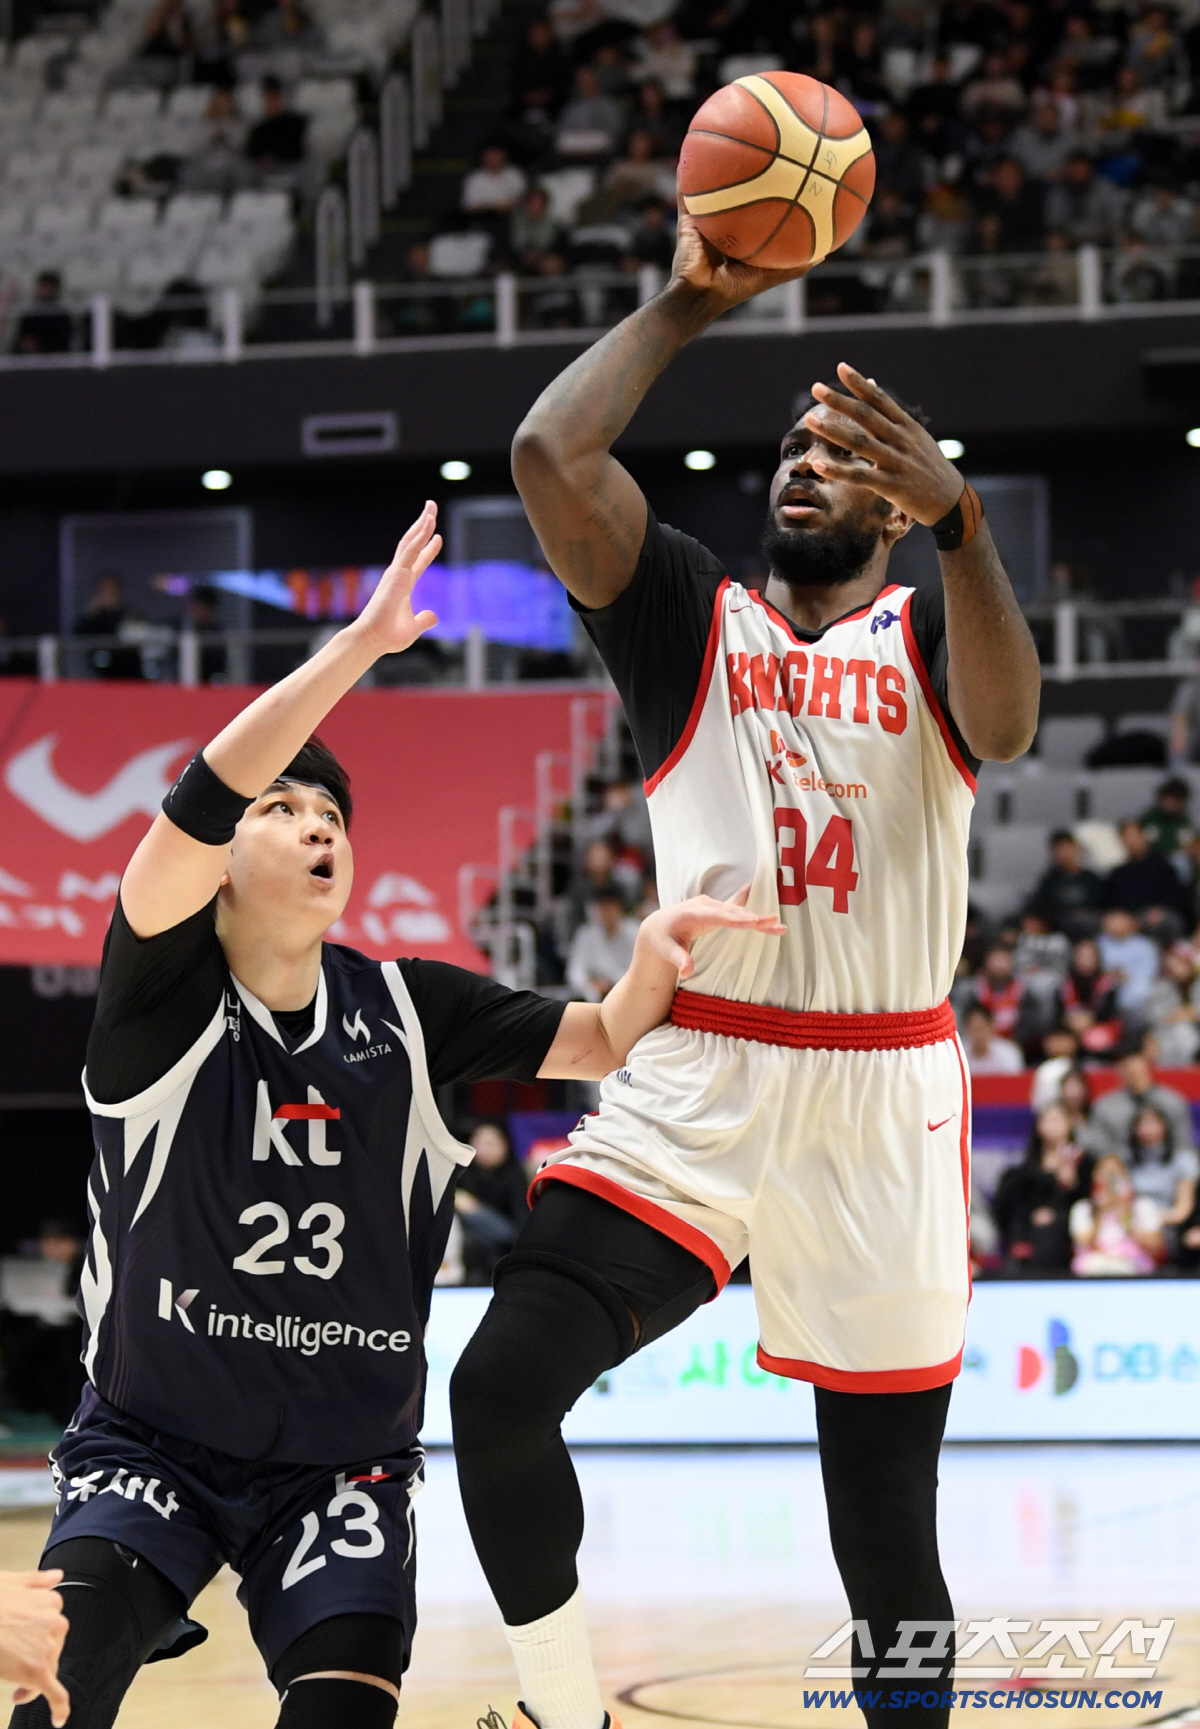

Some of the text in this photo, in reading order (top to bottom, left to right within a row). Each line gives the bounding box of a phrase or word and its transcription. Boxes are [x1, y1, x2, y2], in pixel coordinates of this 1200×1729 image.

[793, 770, 868, 798] telecom
[773, 807, 859, 914] 34
[252, 1079, 341, 1167] kt
[232, 1201, 346, 1280] 23
[158, 1277, 412, 1356] K intelligence
[276, 1490, 386, 1591] 23
